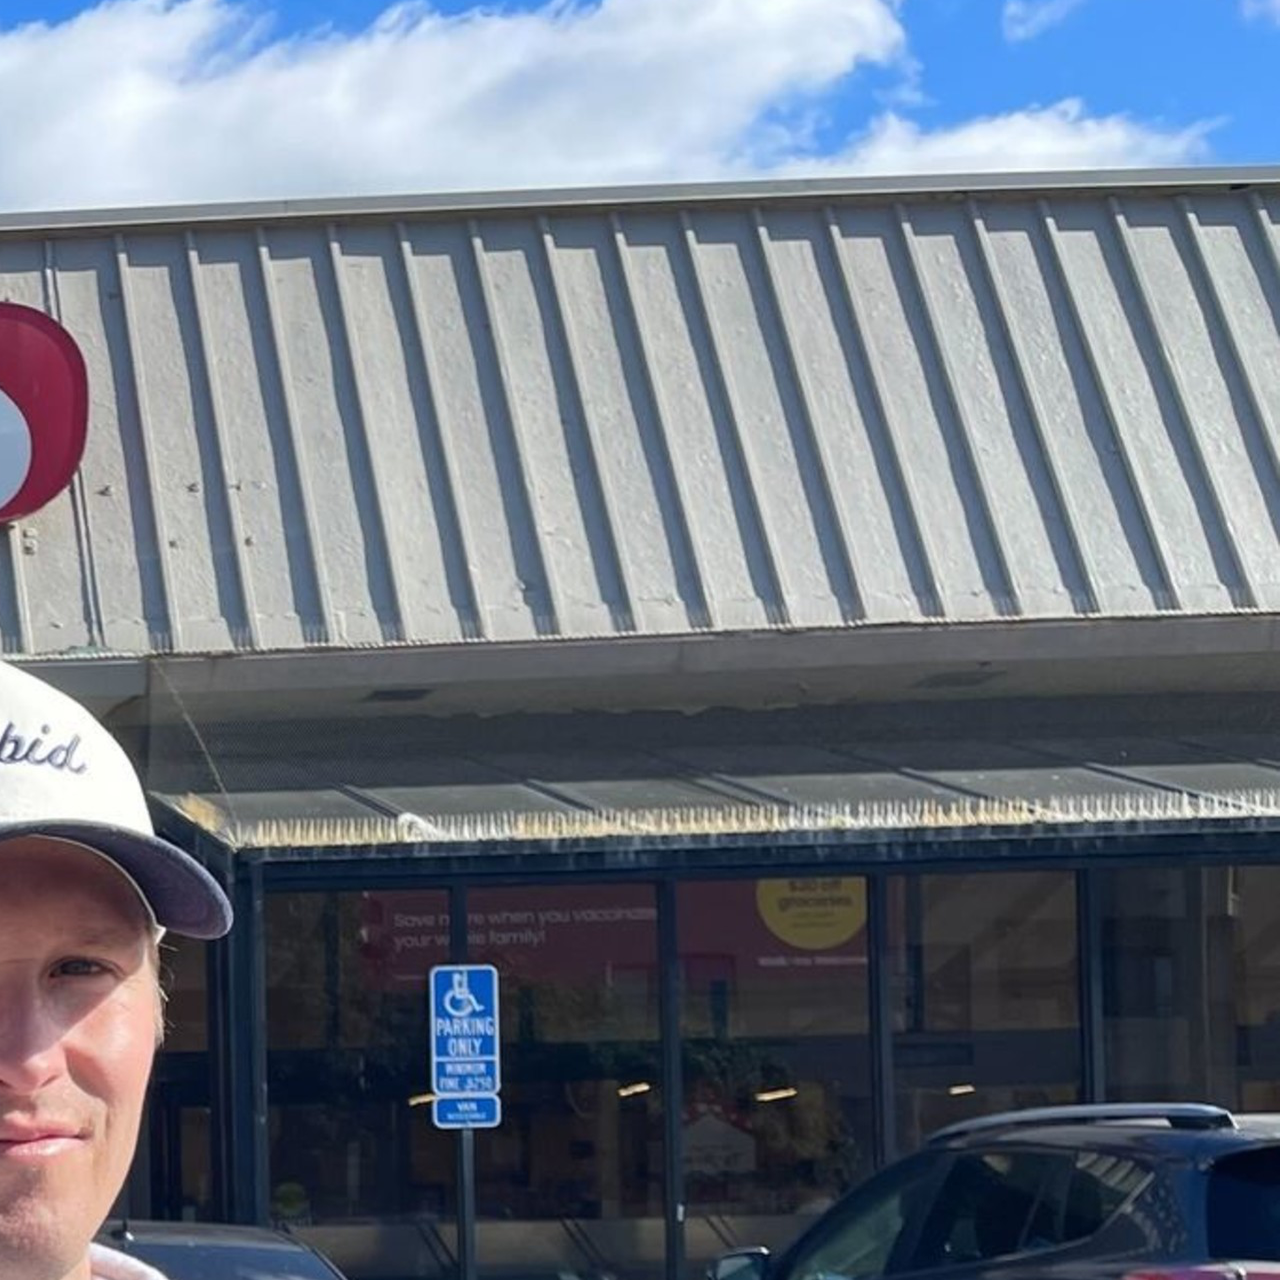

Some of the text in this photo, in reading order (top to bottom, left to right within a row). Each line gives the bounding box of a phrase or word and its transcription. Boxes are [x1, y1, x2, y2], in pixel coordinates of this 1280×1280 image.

[394, 913, 435, 928] Save
[439, 909, 484, 927] mre
[488, 907, 534, 924] when
[538, 908, 571, 926] you
[394, 931, 432, 953] your
[436, 1016, 494, 1036] PARKING
[447, 1037, 483, 1057] ONLY
[457, 1102, 477, 1112] VAN
